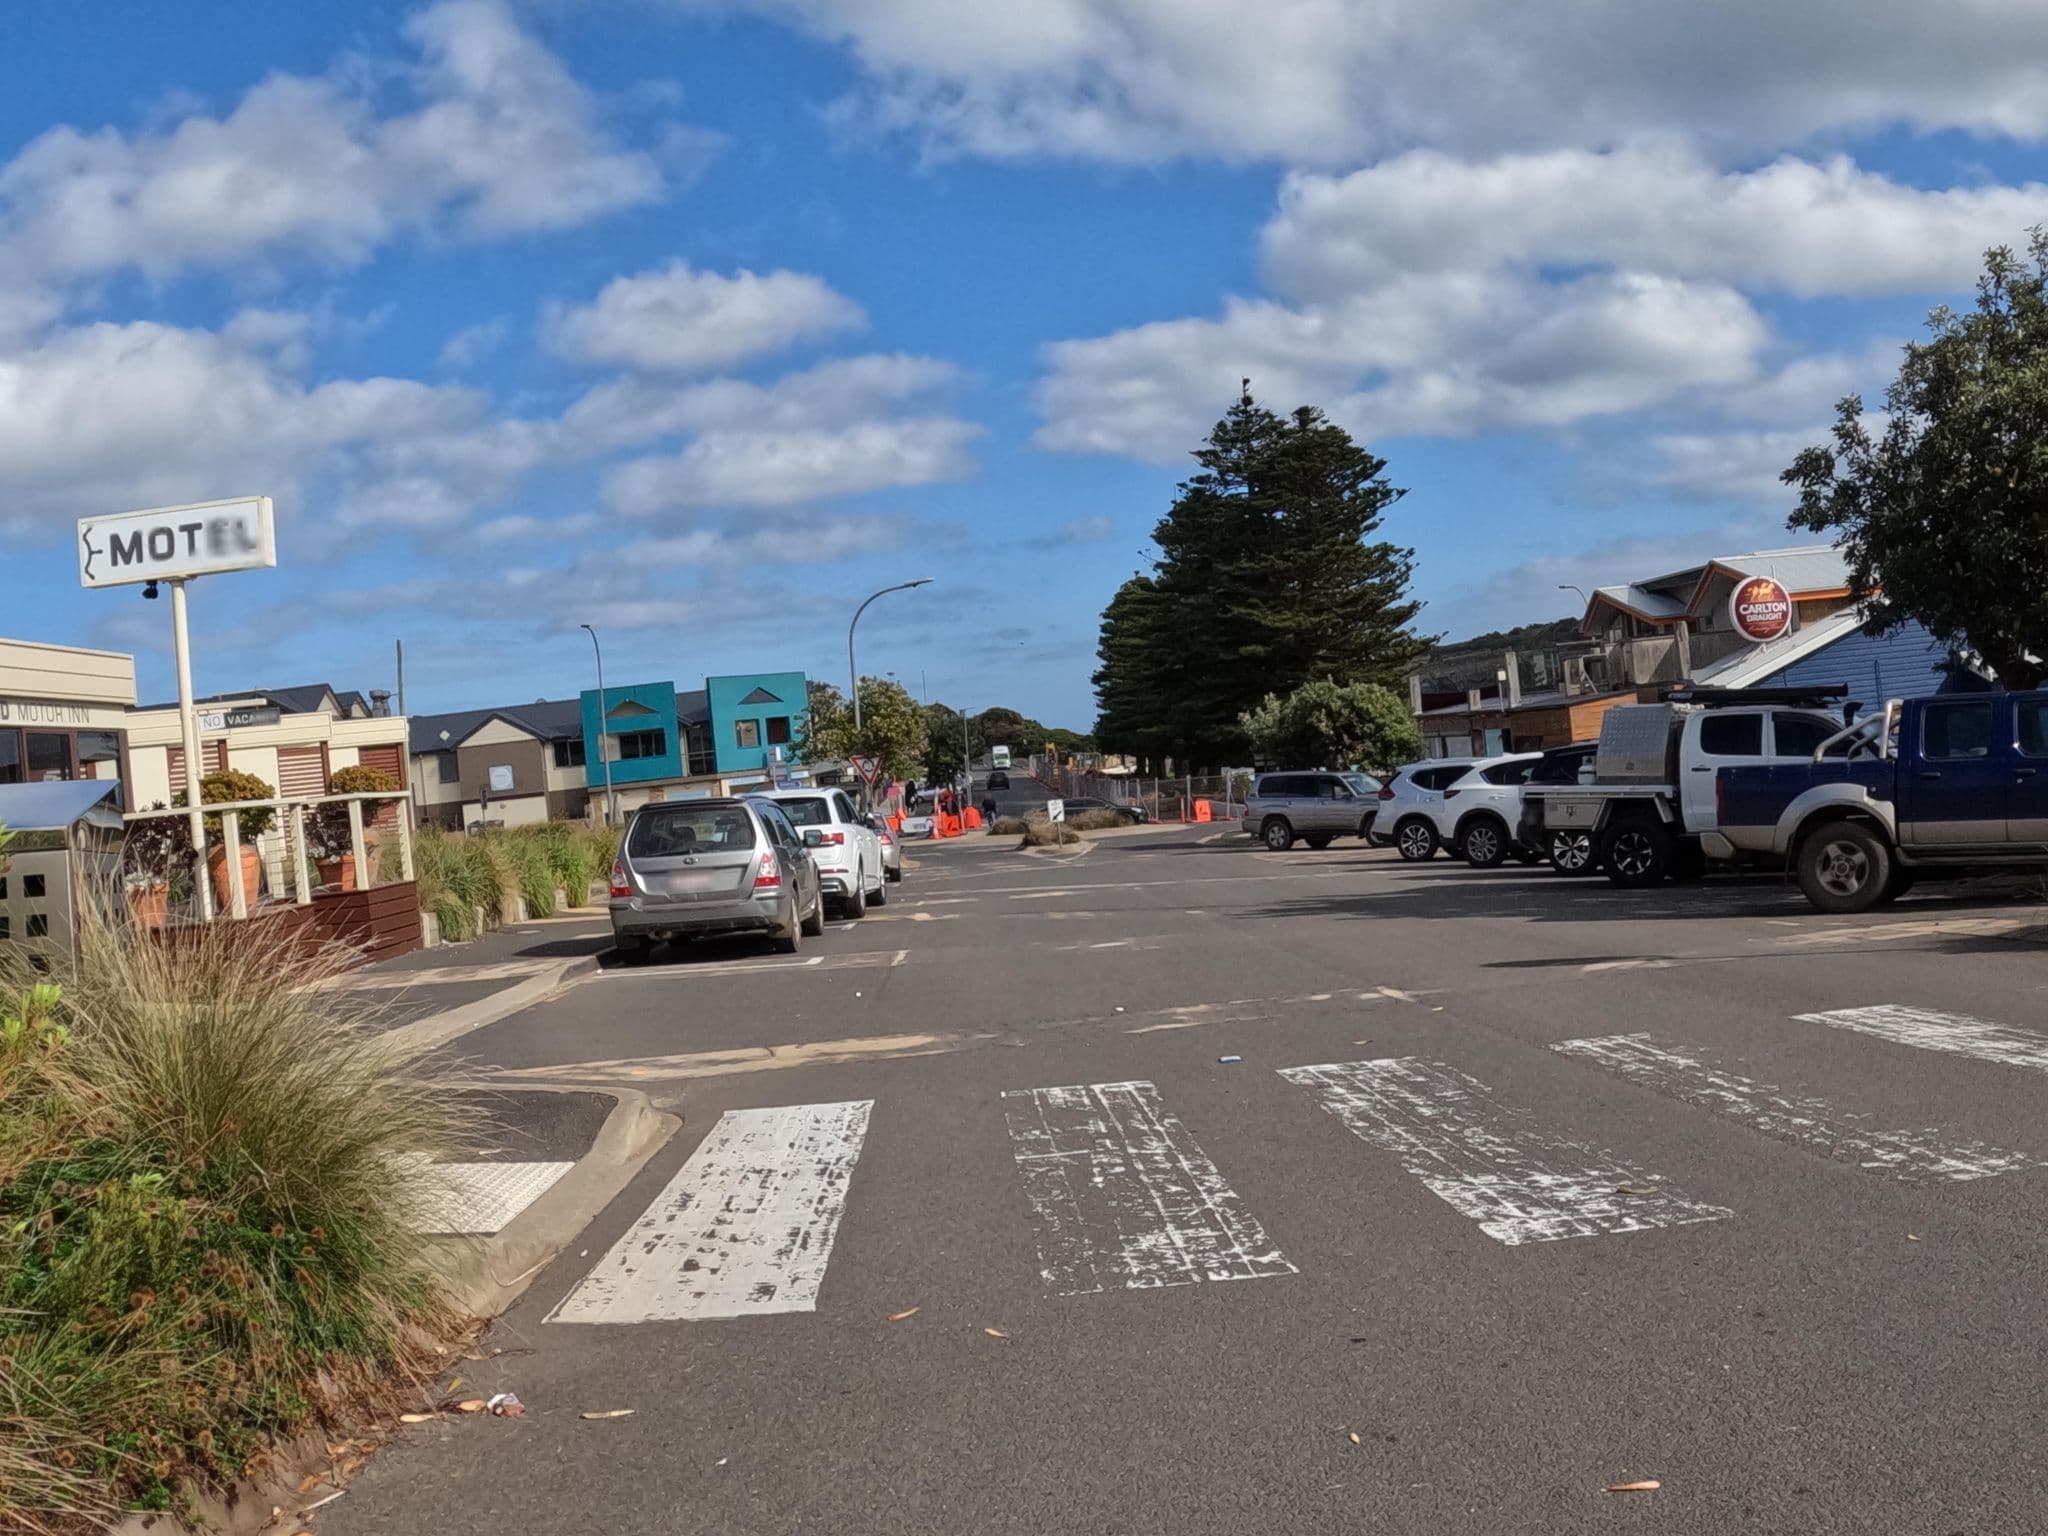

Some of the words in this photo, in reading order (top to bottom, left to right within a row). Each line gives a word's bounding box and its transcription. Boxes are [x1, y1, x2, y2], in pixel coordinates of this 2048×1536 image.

[109, 517, 257, 567] MOT
[1739, 602, 1786, 614] CARLTON
[1746, 612, 1782, 622] DRAUGHT
[17, 702, 63, 722] MOTOR
[68, 704, 90, 724] INN
[203, 715, 221, 728] NO
[227, 710, 279, 726] VACA
